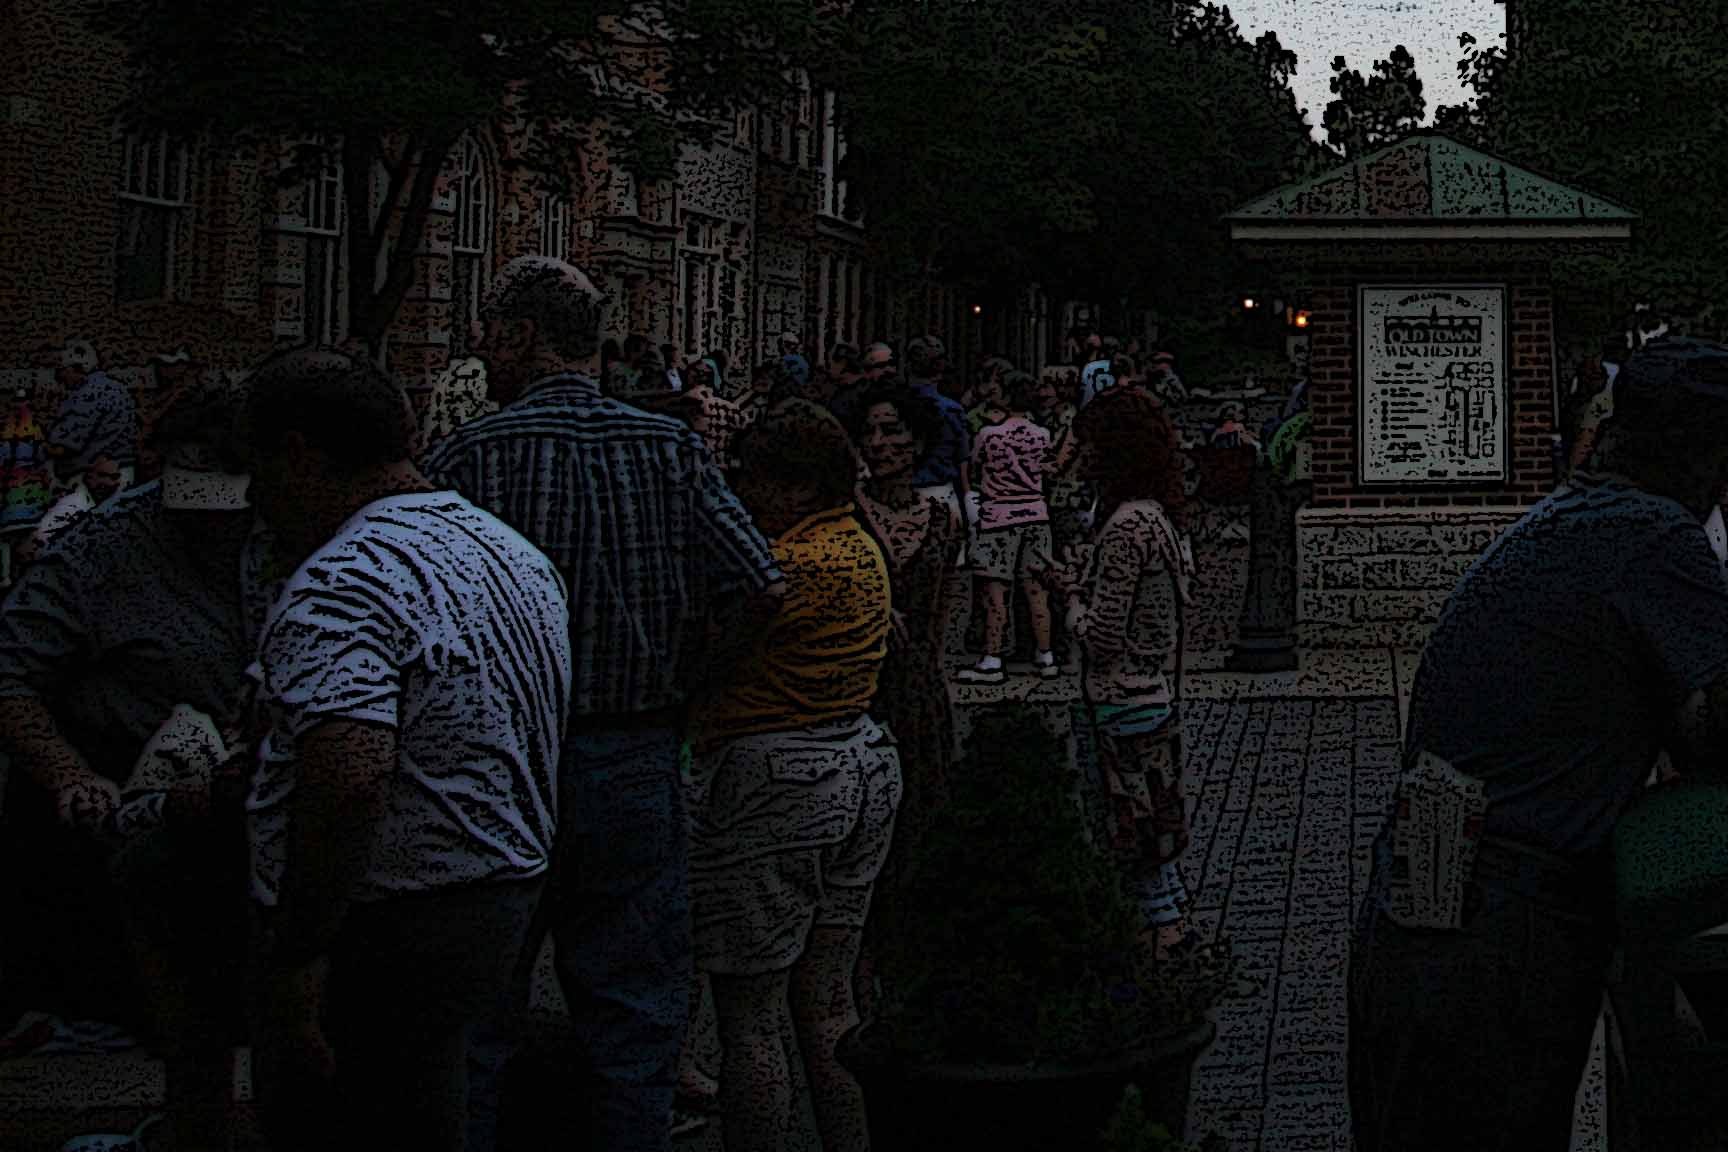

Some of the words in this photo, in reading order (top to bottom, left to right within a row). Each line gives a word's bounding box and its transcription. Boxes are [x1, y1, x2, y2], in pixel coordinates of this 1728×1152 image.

[1387, 328, 1428, 344] OLD
[1428, 327, 1480, 343] TOWN
[1385, 346, 1482, 358] WINCHESTER
